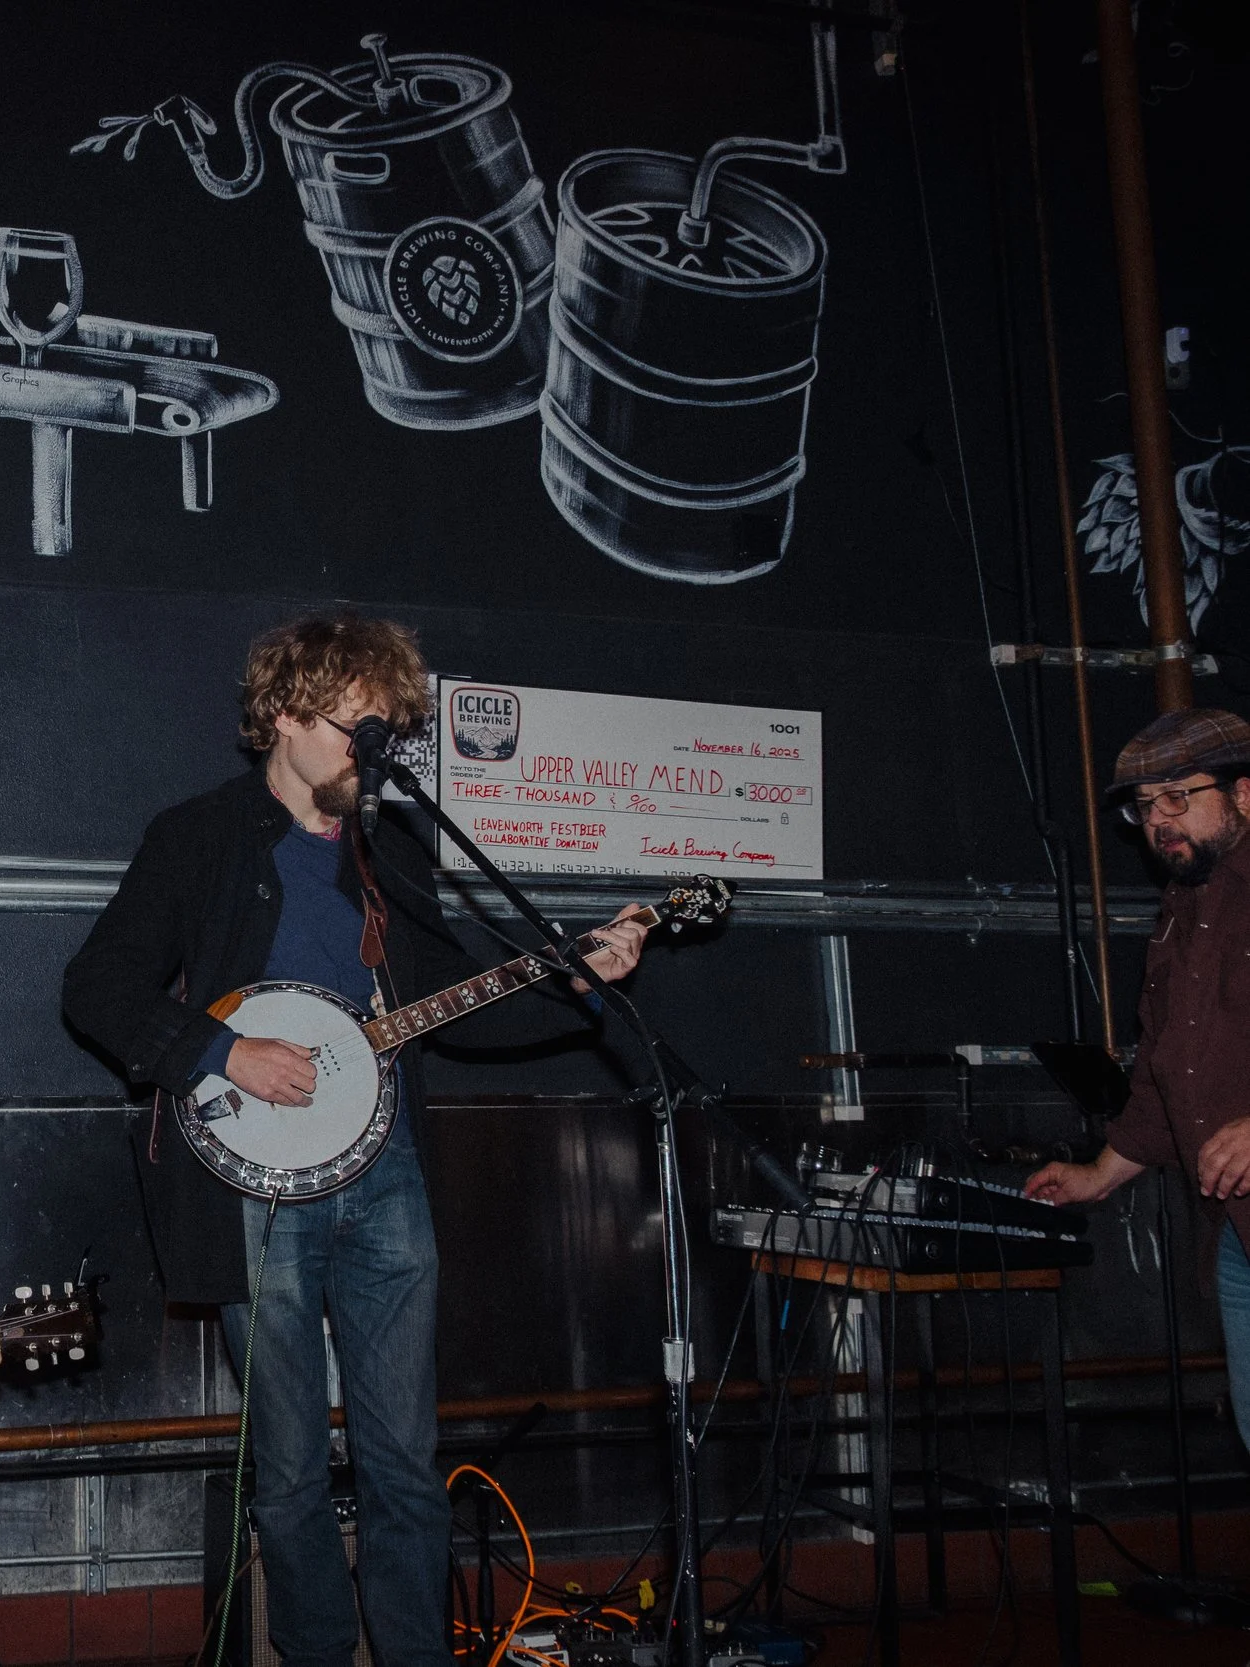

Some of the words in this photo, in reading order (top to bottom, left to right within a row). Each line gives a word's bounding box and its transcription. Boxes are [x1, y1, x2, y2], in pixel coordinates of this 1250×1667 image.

[400, 230, 457, 269] BREWING
[465, 236, 509, 306] COMPANY
[397, 276, 422, 324] ICICLE
[427, 329, 494, 346] LEAVENWORTH
[493, 315, 505, 328] WA
[2, 369, 40, 392] Graphics
[458, 695, 512, 716] ICICLE
[459, 714, 511, 726] BREWING
[769, 724, 800, 735] 1001
[769, 747, 800, 759] 2025
[520, 755, 575, 783] UPPER
[582, 759, 639, 788] VALLEY
[649, 764, 724, 795] MEND
[474, 818, 544, 834] LEAVENWORTH
[550, 822, 607, 838] FESTBIER
[740, 816, 770, 824] DOLLARS
[475, 833, 550, 848] COLLABORATIVE
[556, 838, 600, 850] DONATION
[641, 836, 680, 856] Icicle
[683, 838, 729, 862] Brewing
[733, 841, 776, 867] Company
